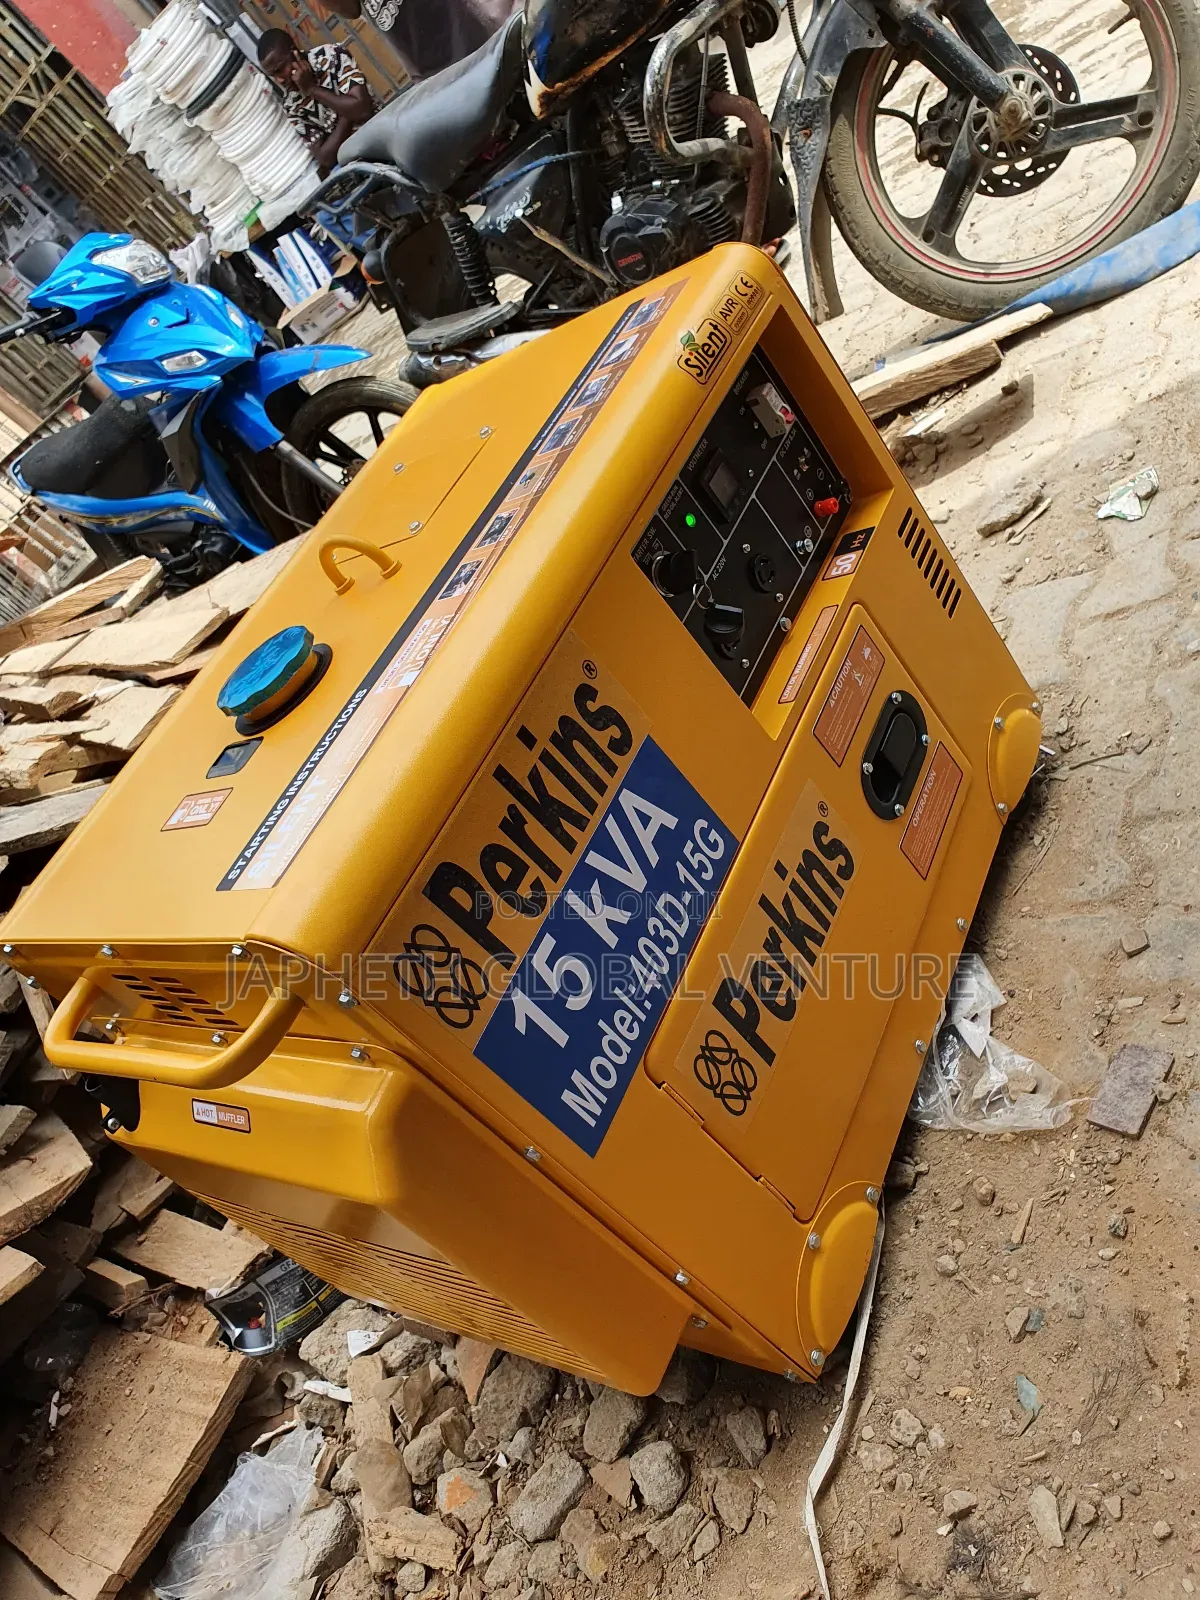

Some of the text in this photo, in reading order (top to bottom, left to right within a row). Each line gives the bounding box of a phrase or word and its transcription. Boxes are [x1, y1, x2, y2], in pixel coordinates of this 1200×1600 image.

[719, 298, 739, 321] AVR
[684, 321, 727, 378] Silent
[732, 370, 750, 396] BREAKER
[686, 437, 709, 472] VOLTMETER
[633, 538, 650, 563] TARTER
[711, 555, 728, 581] AC 220V
[831, 532, 866, 578] 50 Hz
[832, 659, 853, 700] CAUTION
[227, 687, 368, 881] STARTING INSTRUCTIONS
[911, 769, 937, 828] OPERATION
[247, 775, 328, 879] SILENT
[512, 787, 680, 1049] 15 kVA
[559, 817, 728, 1128] Model:403D-15G
[217, 1111, 246, 1126] MUFFLER
